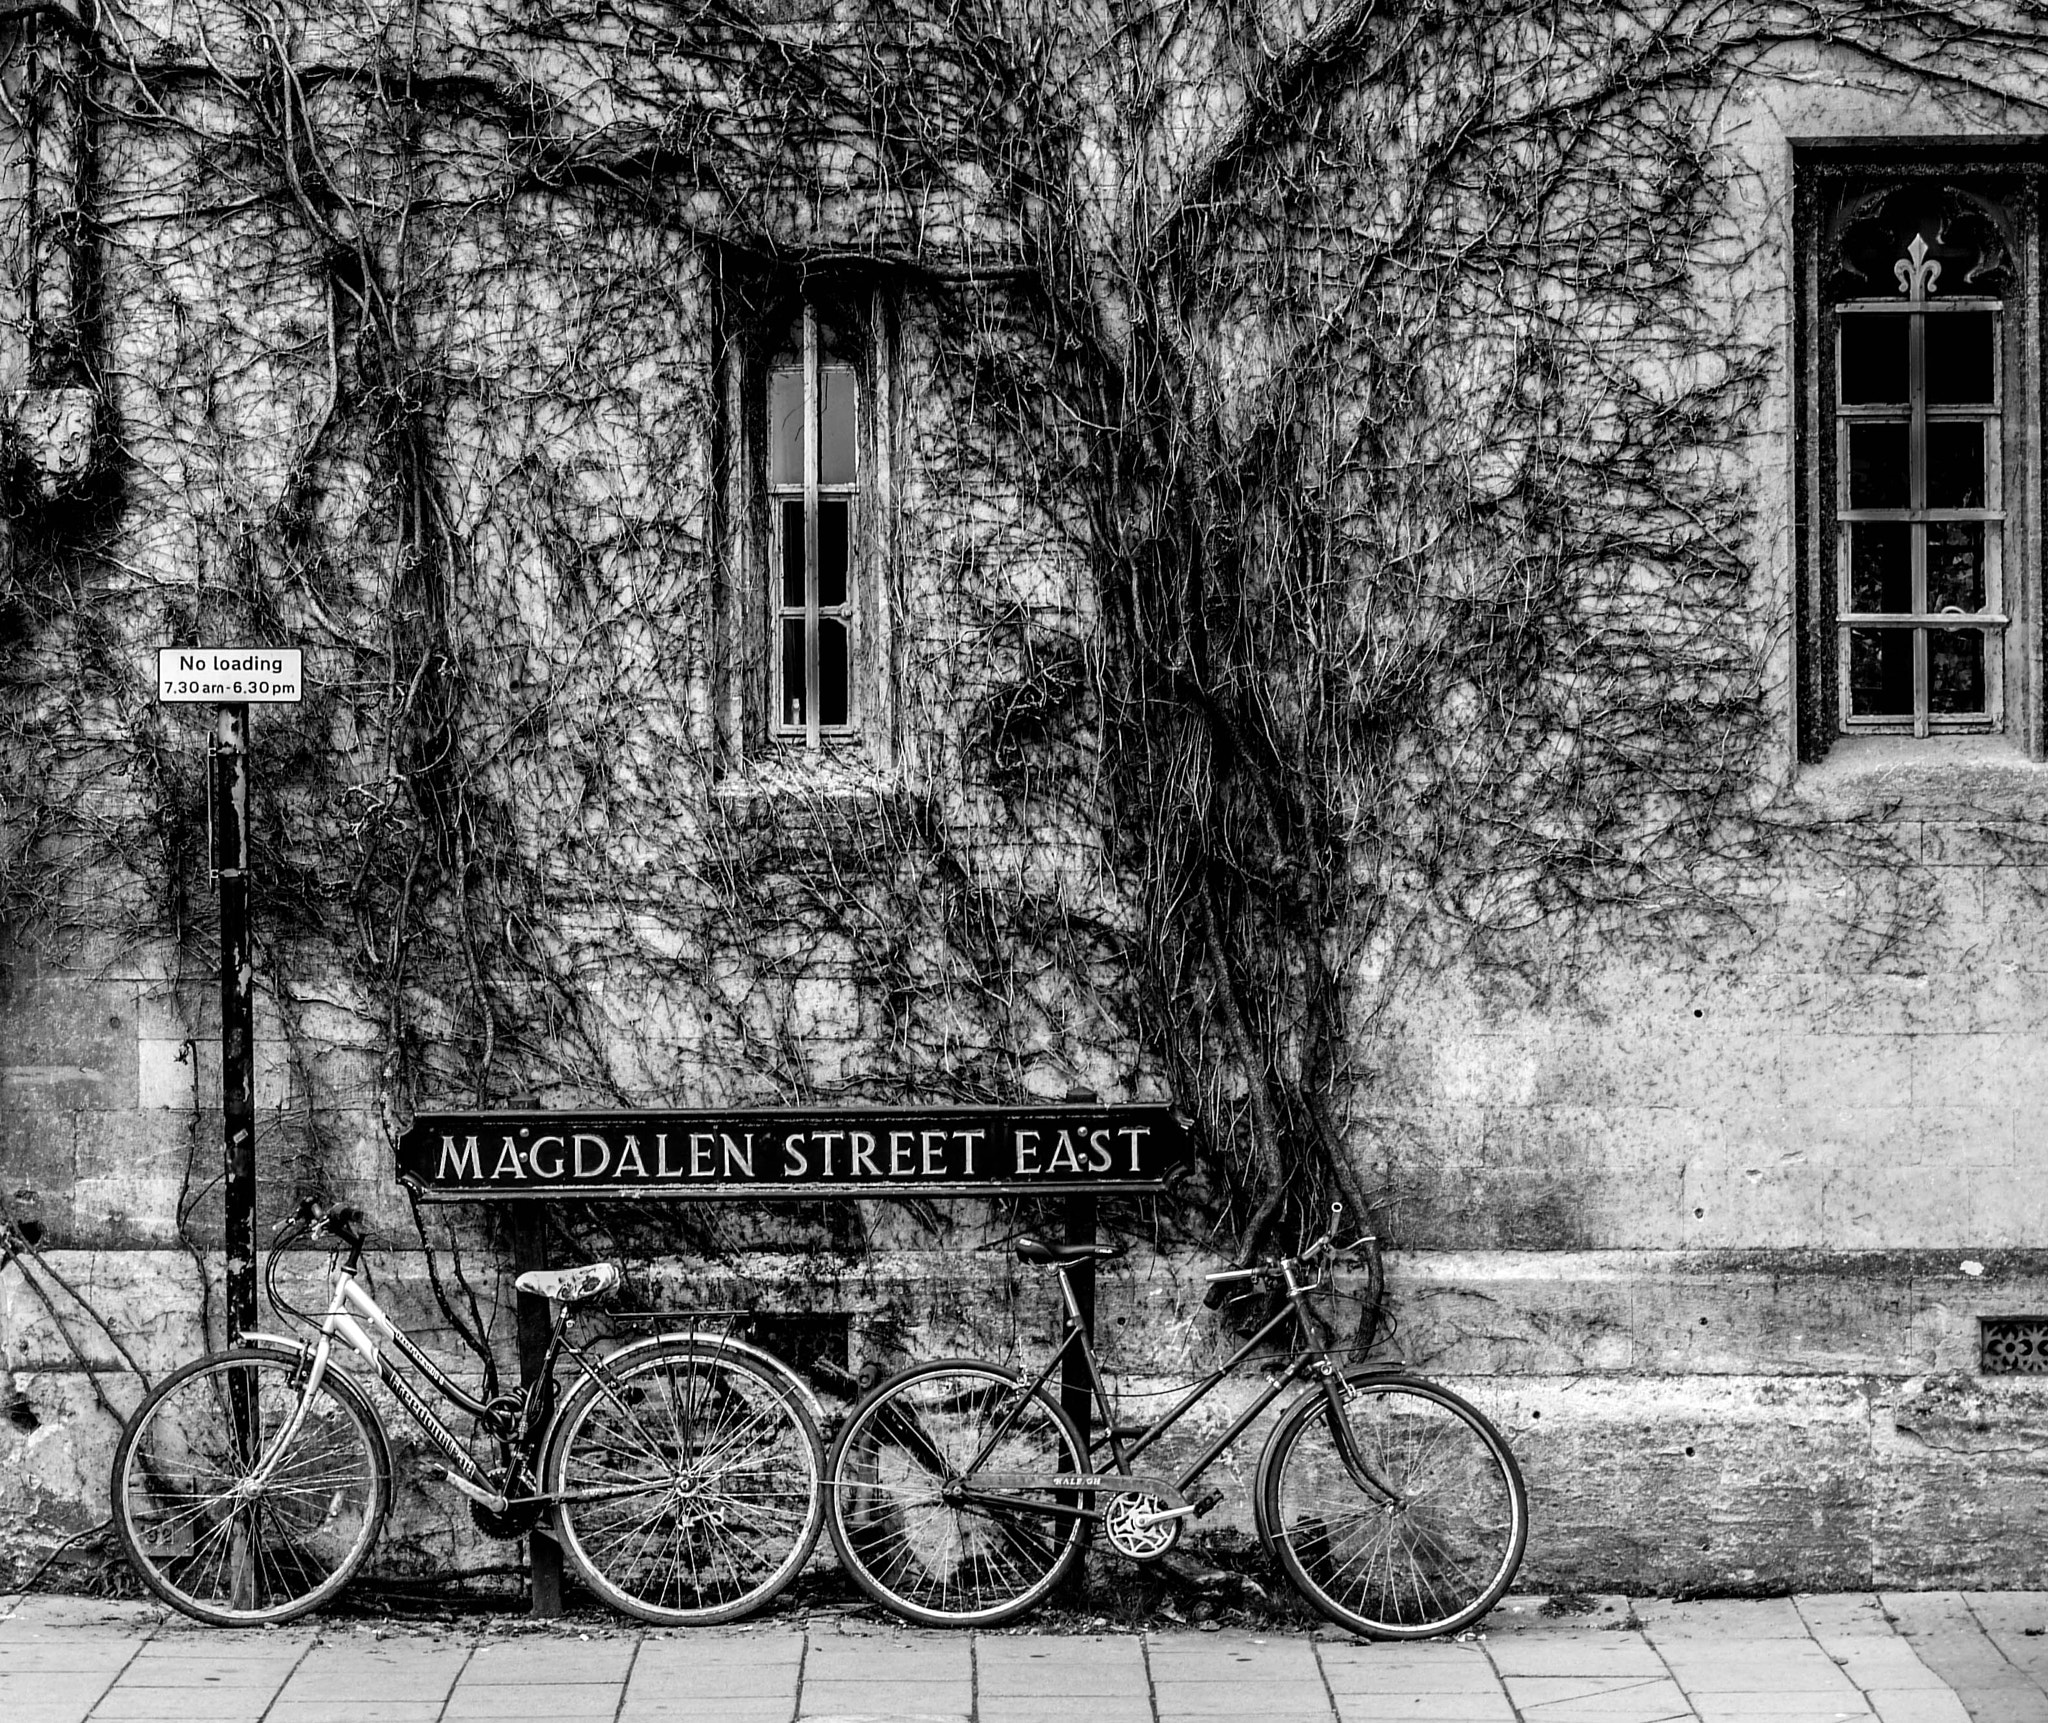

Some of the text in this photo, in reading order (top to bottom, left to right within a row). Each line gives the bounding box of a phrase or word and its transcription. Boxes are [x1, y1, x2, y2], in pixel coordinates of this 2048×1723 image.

[180, 655, 282, 674] No loading
[436, 1126, 1151, 1180] MAGDALEN STREET EAST
